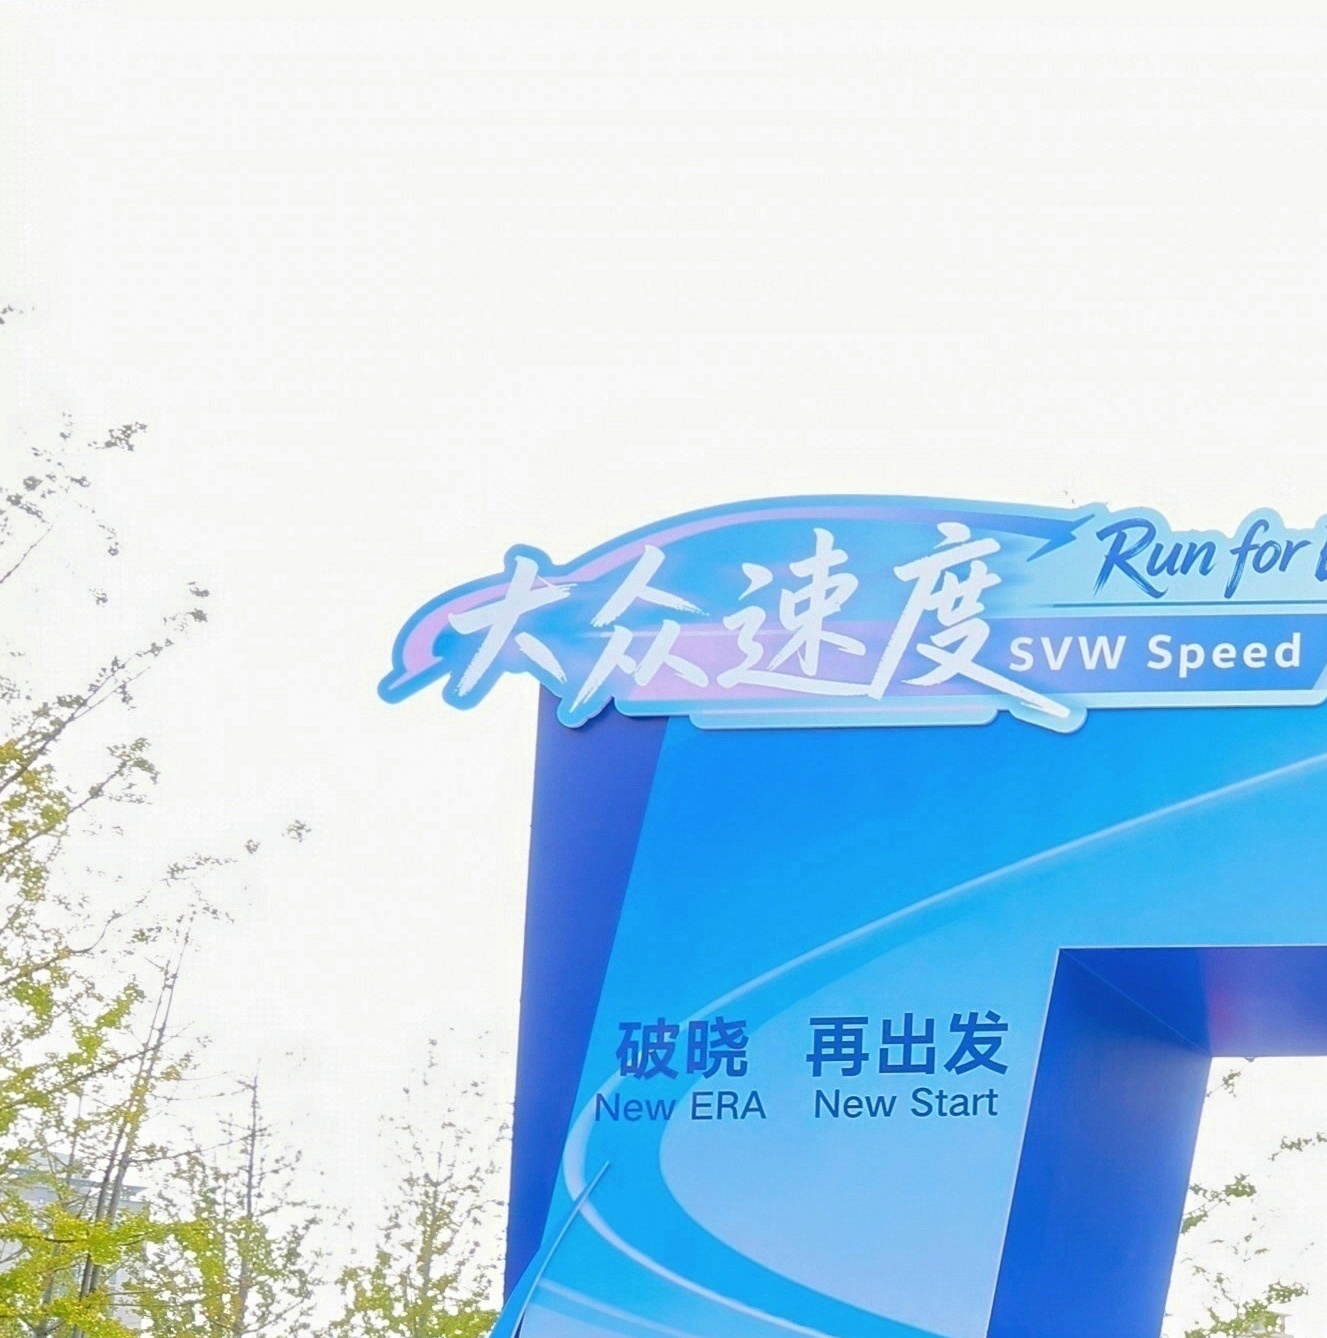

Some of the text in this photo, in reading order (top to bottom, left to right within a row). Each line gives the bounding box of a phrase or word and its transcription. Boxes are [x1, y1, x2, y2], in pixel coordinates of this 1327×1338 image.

[1093, 520, 1215, 600] Run
[1226, 519, 1300, 601] for
[446, 521, 1076, 720] 大众速度
[1008, 631, 1304, 680] SVW Speed
[615, 1012, 1010, 1079] 破晓 再出发
[594, 1087, 1000, 1123] New ERA New Start
